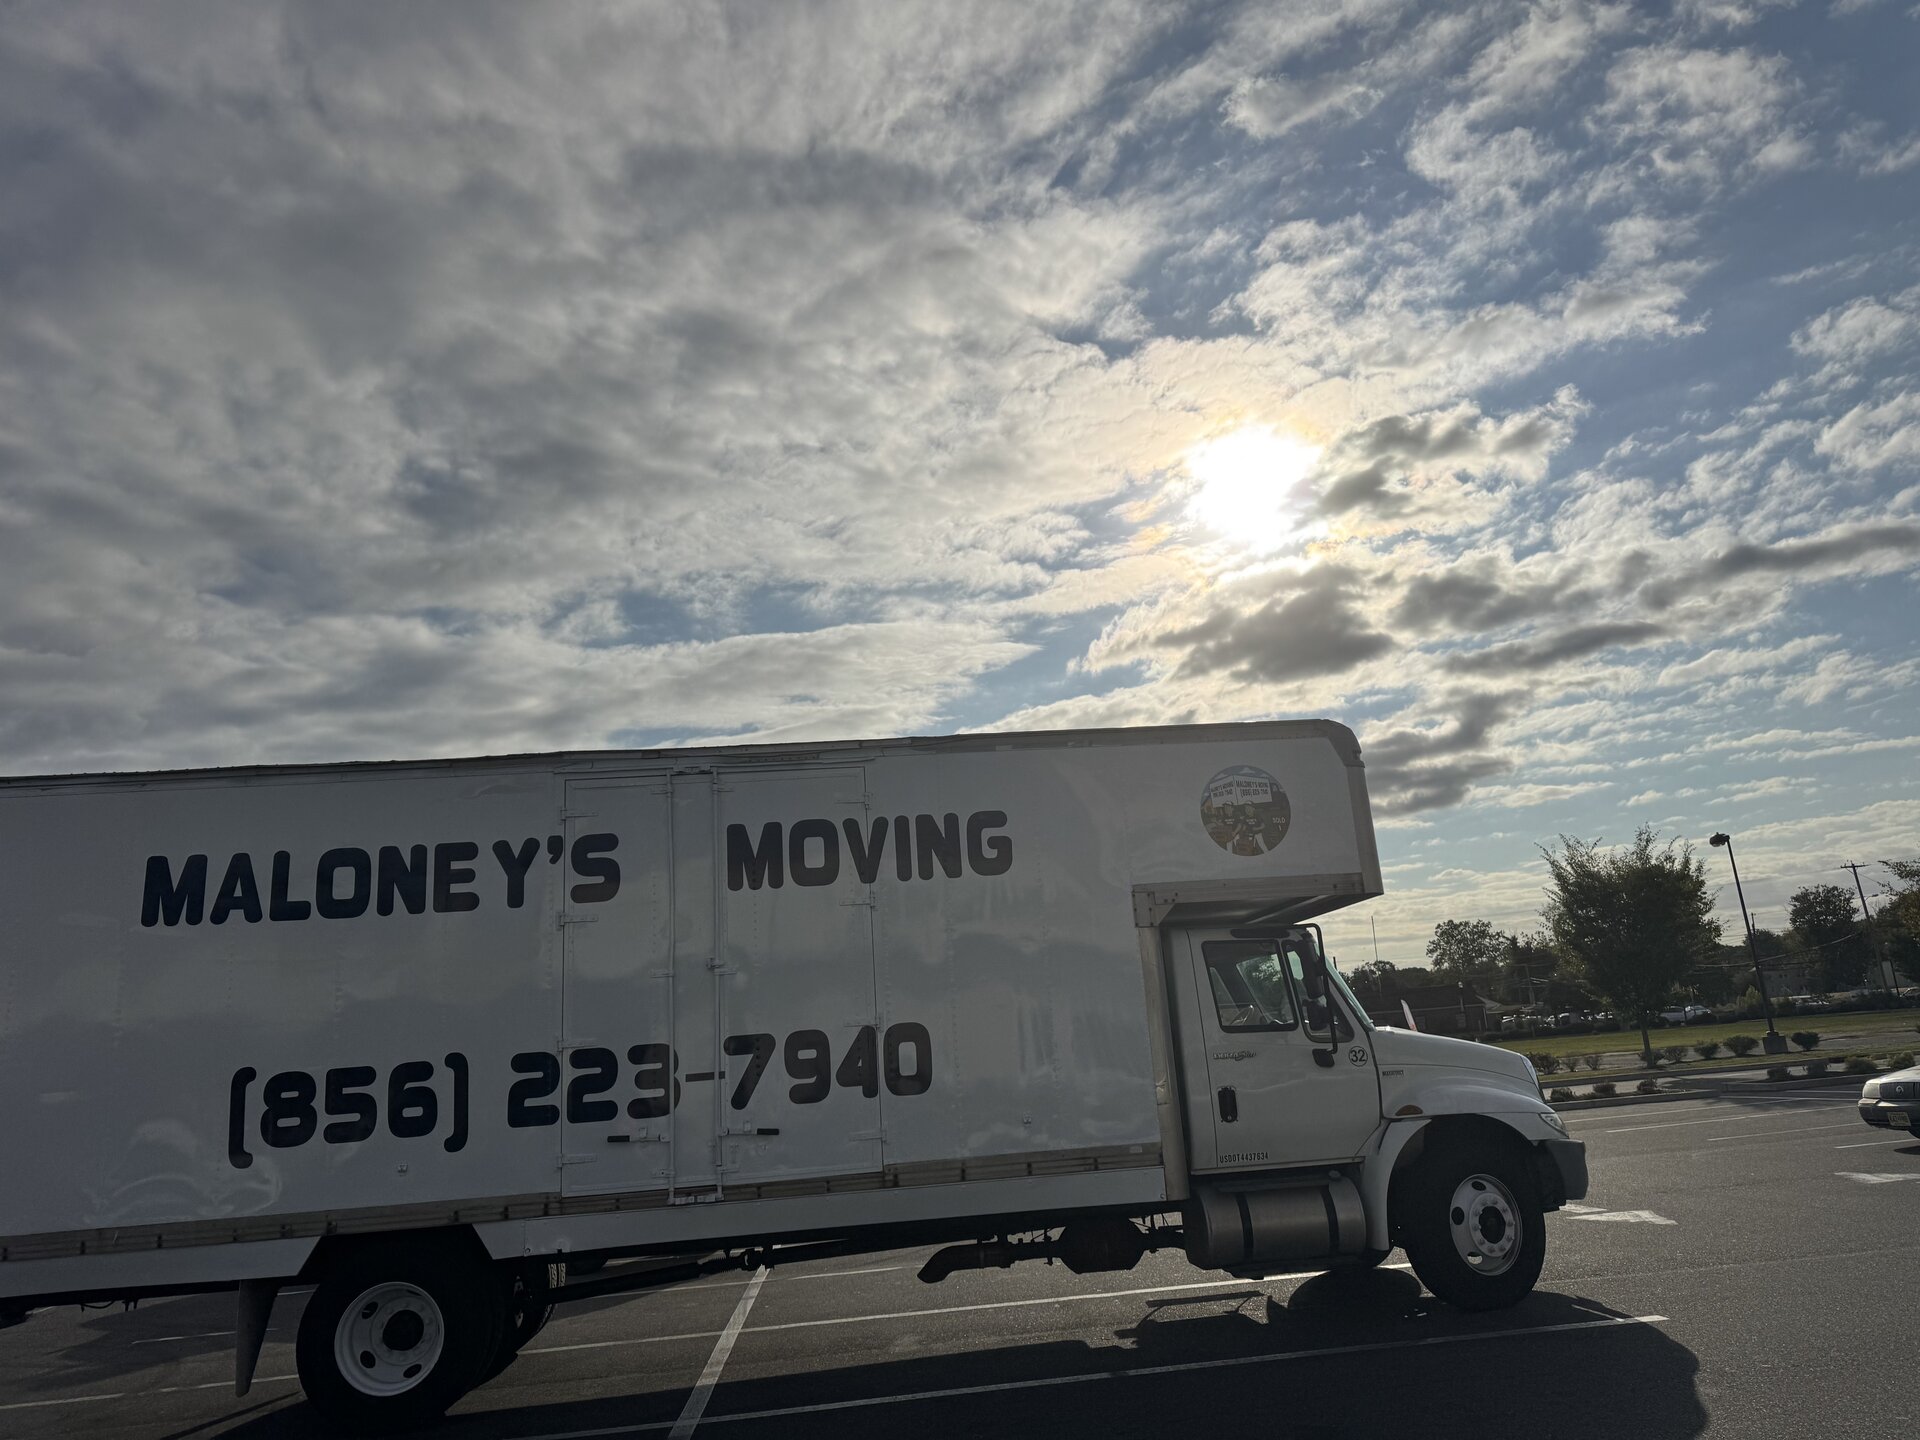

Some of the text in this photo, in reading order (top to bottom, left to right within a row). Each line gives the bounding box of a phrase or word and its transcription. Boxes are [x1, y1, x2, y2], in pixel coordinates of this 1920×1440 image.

[141, 810, 1013, 927] MALONEY'S MOVING
[228, 1022, 933, 1169] (856) 223-7940
[1350, 1049, 1366, 1063] 32
